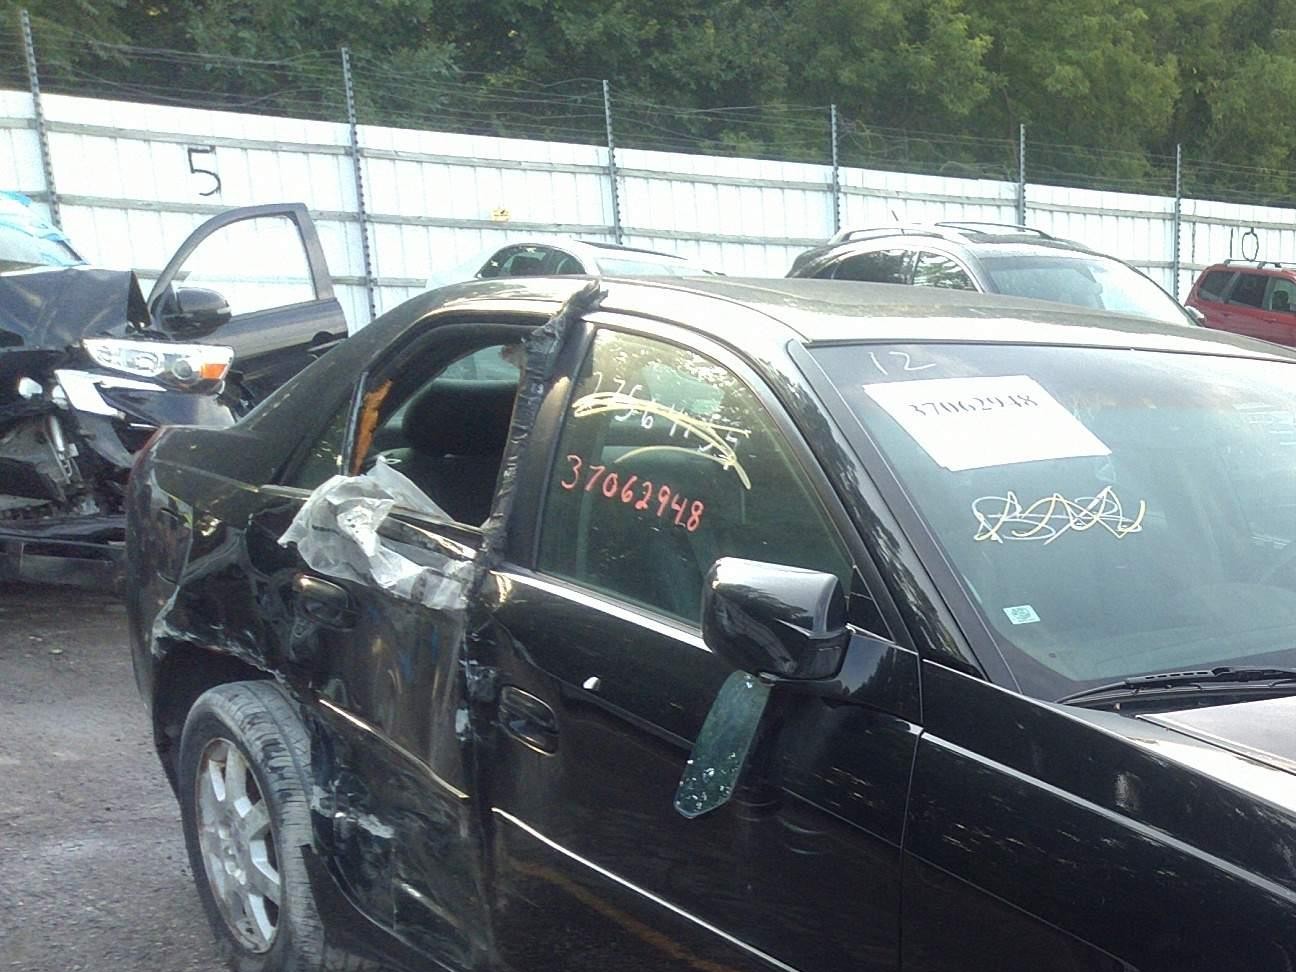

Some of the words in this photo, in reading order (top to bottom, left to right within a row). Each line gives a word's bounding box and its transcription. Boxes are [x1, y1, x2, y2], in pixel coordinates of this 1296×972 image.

[187, 145, 221, 197] 5
[1229, 227, 1259, 262] 10
[868, 351, 937, 376] 12
[908, 394, 1039, 416] 37062948
[561, 454, 704, 532] 37062948
